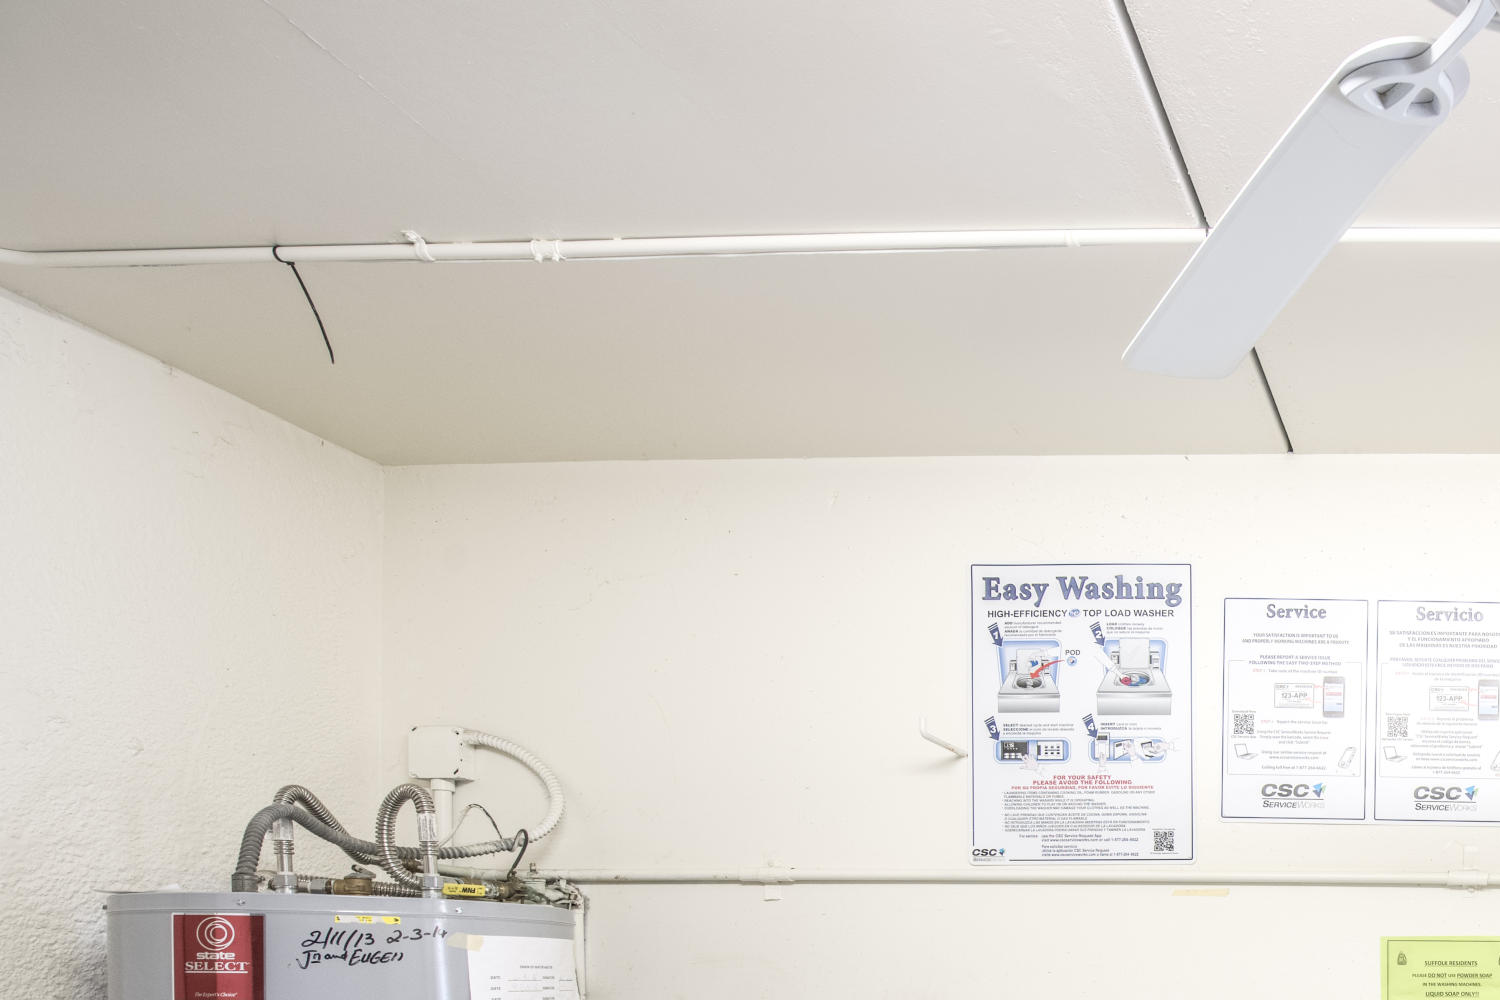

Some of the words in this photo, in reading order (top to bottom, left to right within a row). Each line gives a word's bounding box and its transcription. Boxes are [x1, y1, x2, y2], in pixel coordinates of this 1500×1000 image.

[982, 576, 1049, 607] Easy
[1056, 574, 1183, 607] Washing
[987, 609, 1067, 618] HIGH-EFFICIENCY
[1083, 609, 1102, 617] TOP
[1105, 609, 1131, 617] LOAD
[1134, 609, 1174, 617] WASHER
[1266, 603, 1327, 619] Service
[1415, 606, 1484, 622] Servicio
[1261, 783, 1310, 798] CSC
[1413, 786, 1462, 800] CSC
[972, 848, 997, 857] CSC
[196, 951, 236, 960] state
[184, 961, 249, 971] SELECT
